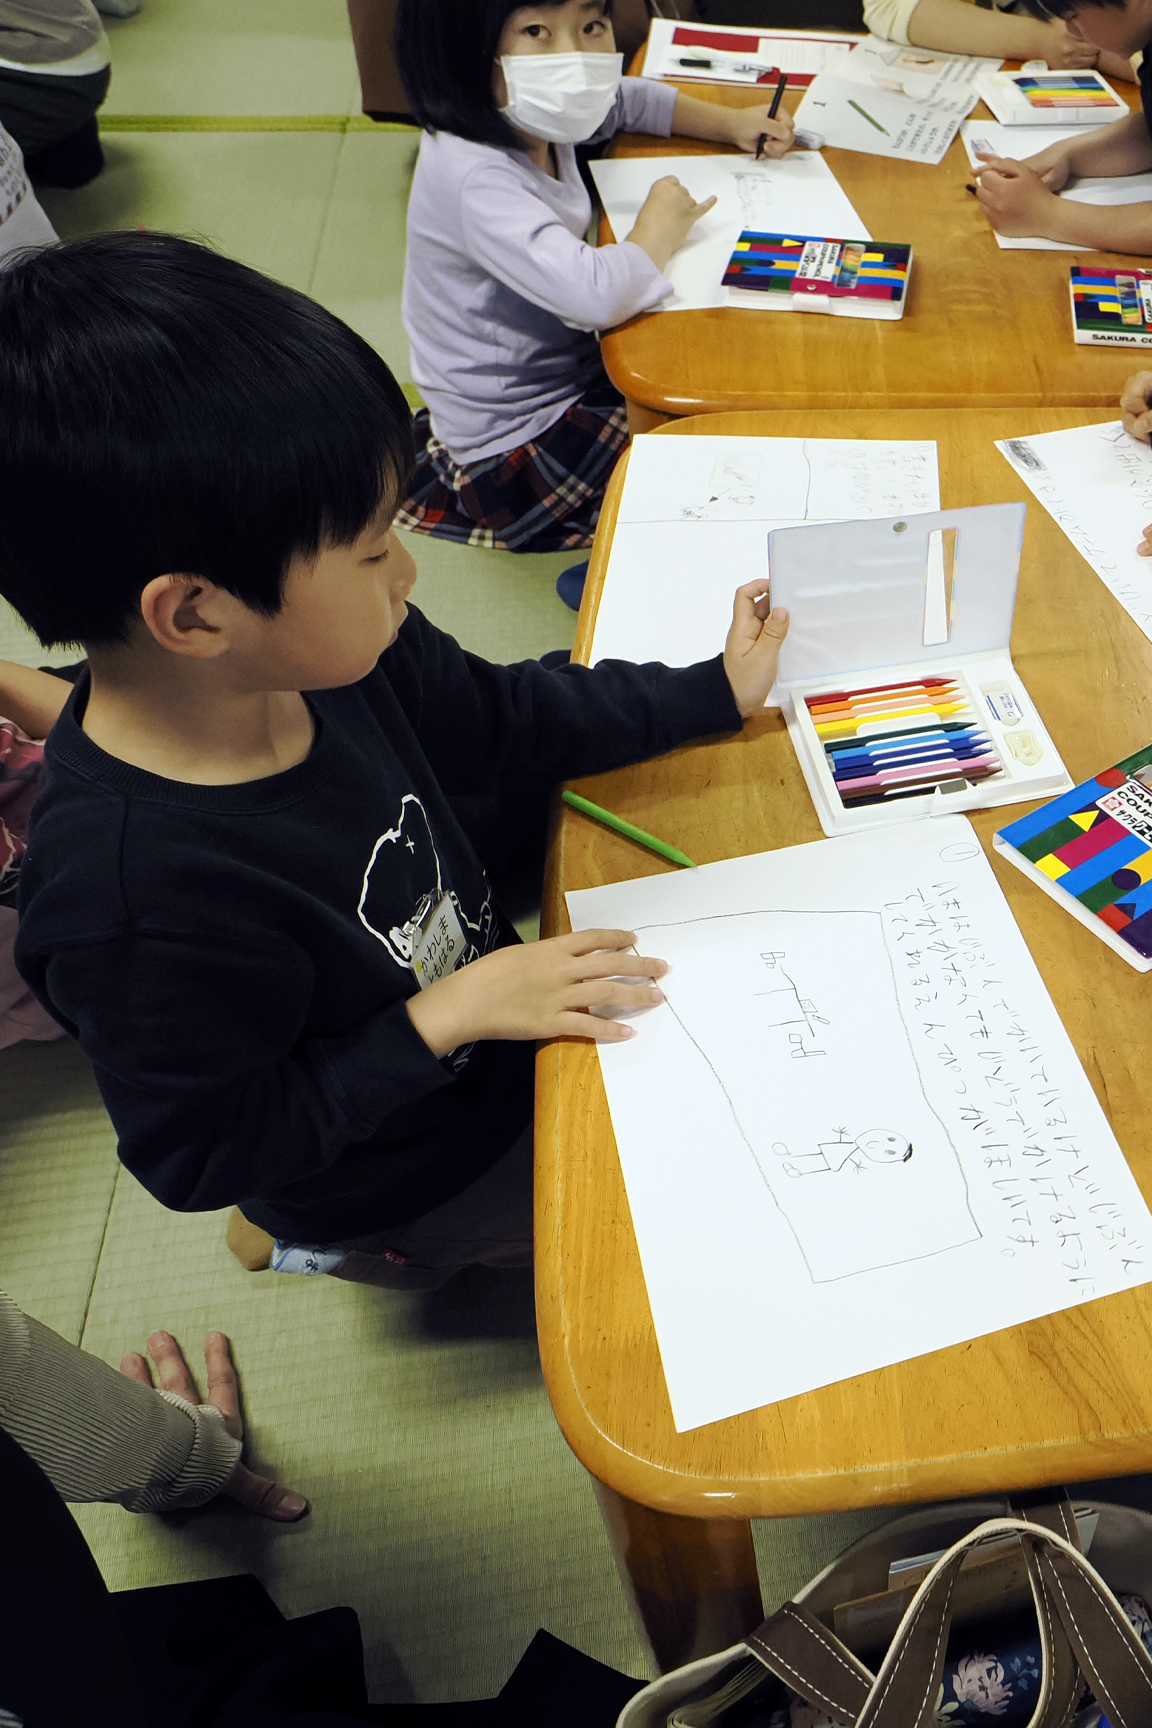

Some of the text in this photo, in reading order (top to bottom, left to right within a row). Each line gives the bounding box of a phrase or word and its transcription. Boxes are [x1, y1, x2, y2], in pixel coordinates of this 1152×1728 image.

[1092, 334, 1137, 343] SAKURA
[421, 914, 448, 975] かわしま
